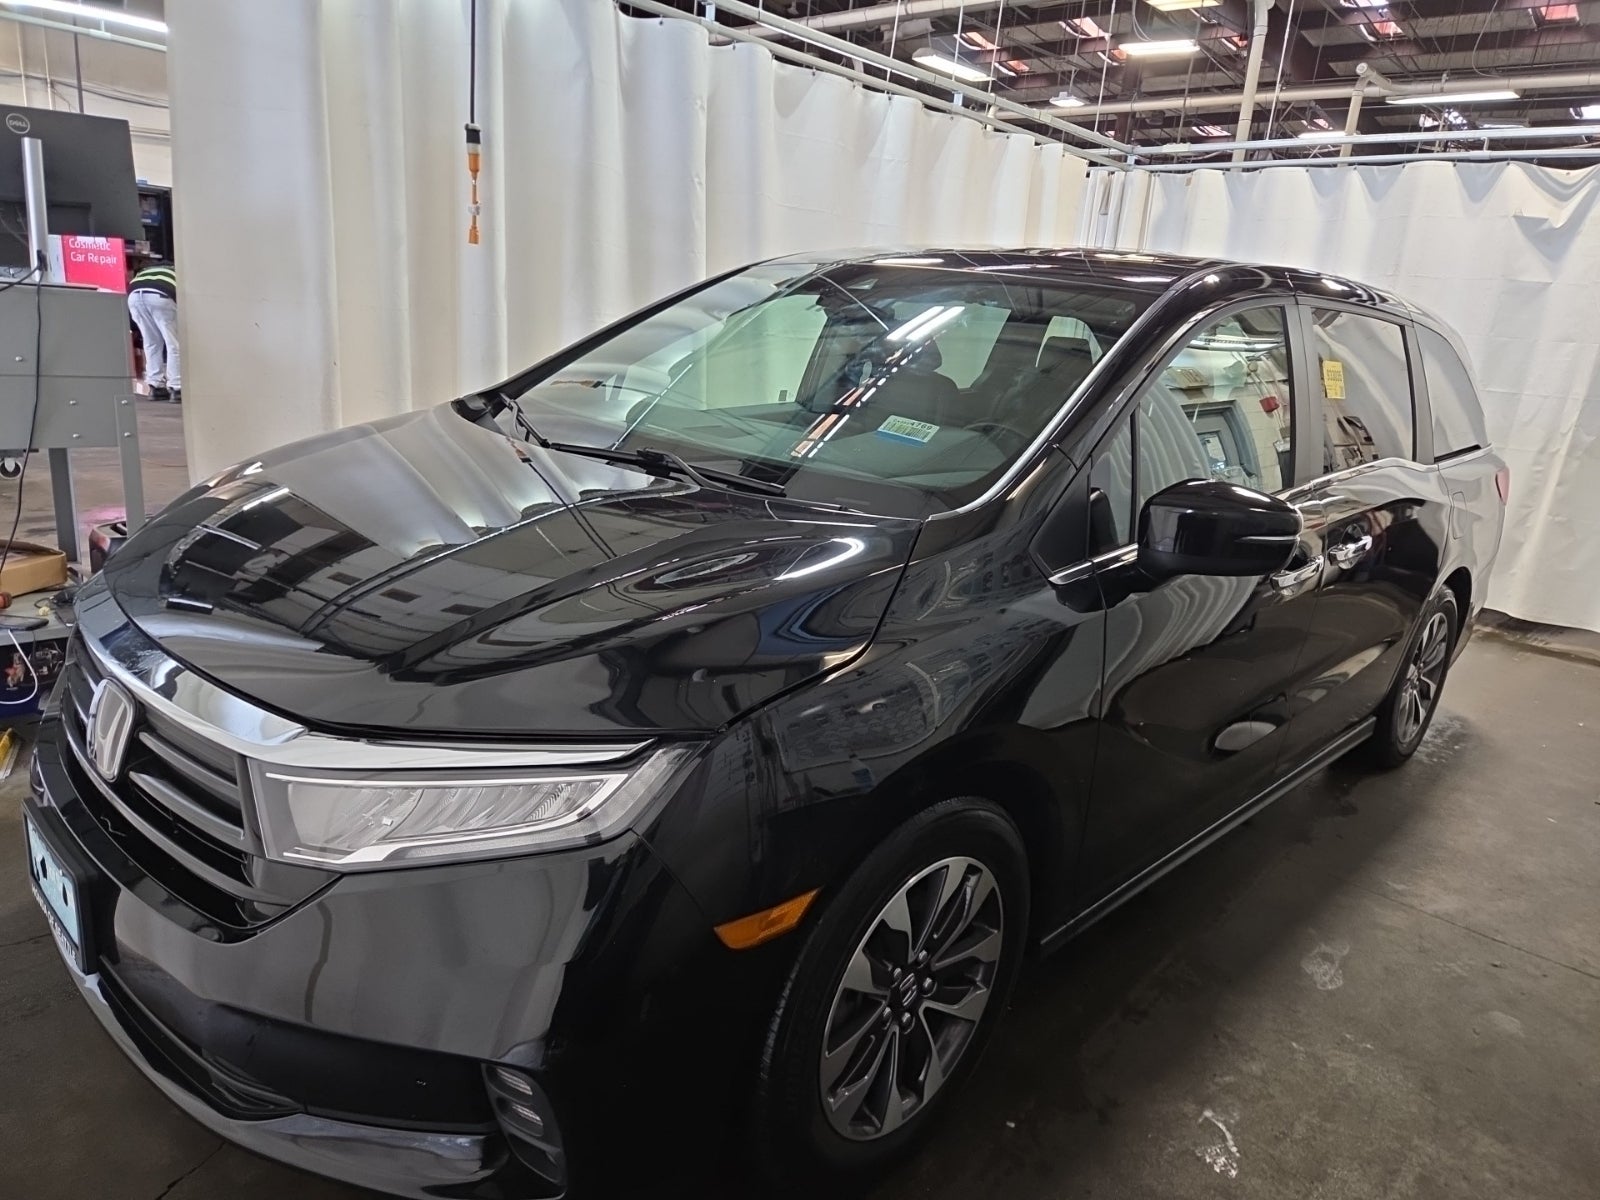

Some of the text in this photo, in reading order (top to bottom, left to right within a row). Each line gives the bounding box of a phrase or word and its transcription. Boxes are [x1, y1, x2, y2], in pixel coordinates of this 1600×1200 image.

[69, 239, 111, 251] Cosmetic
[71, 252, 117, 265] Car Repair
